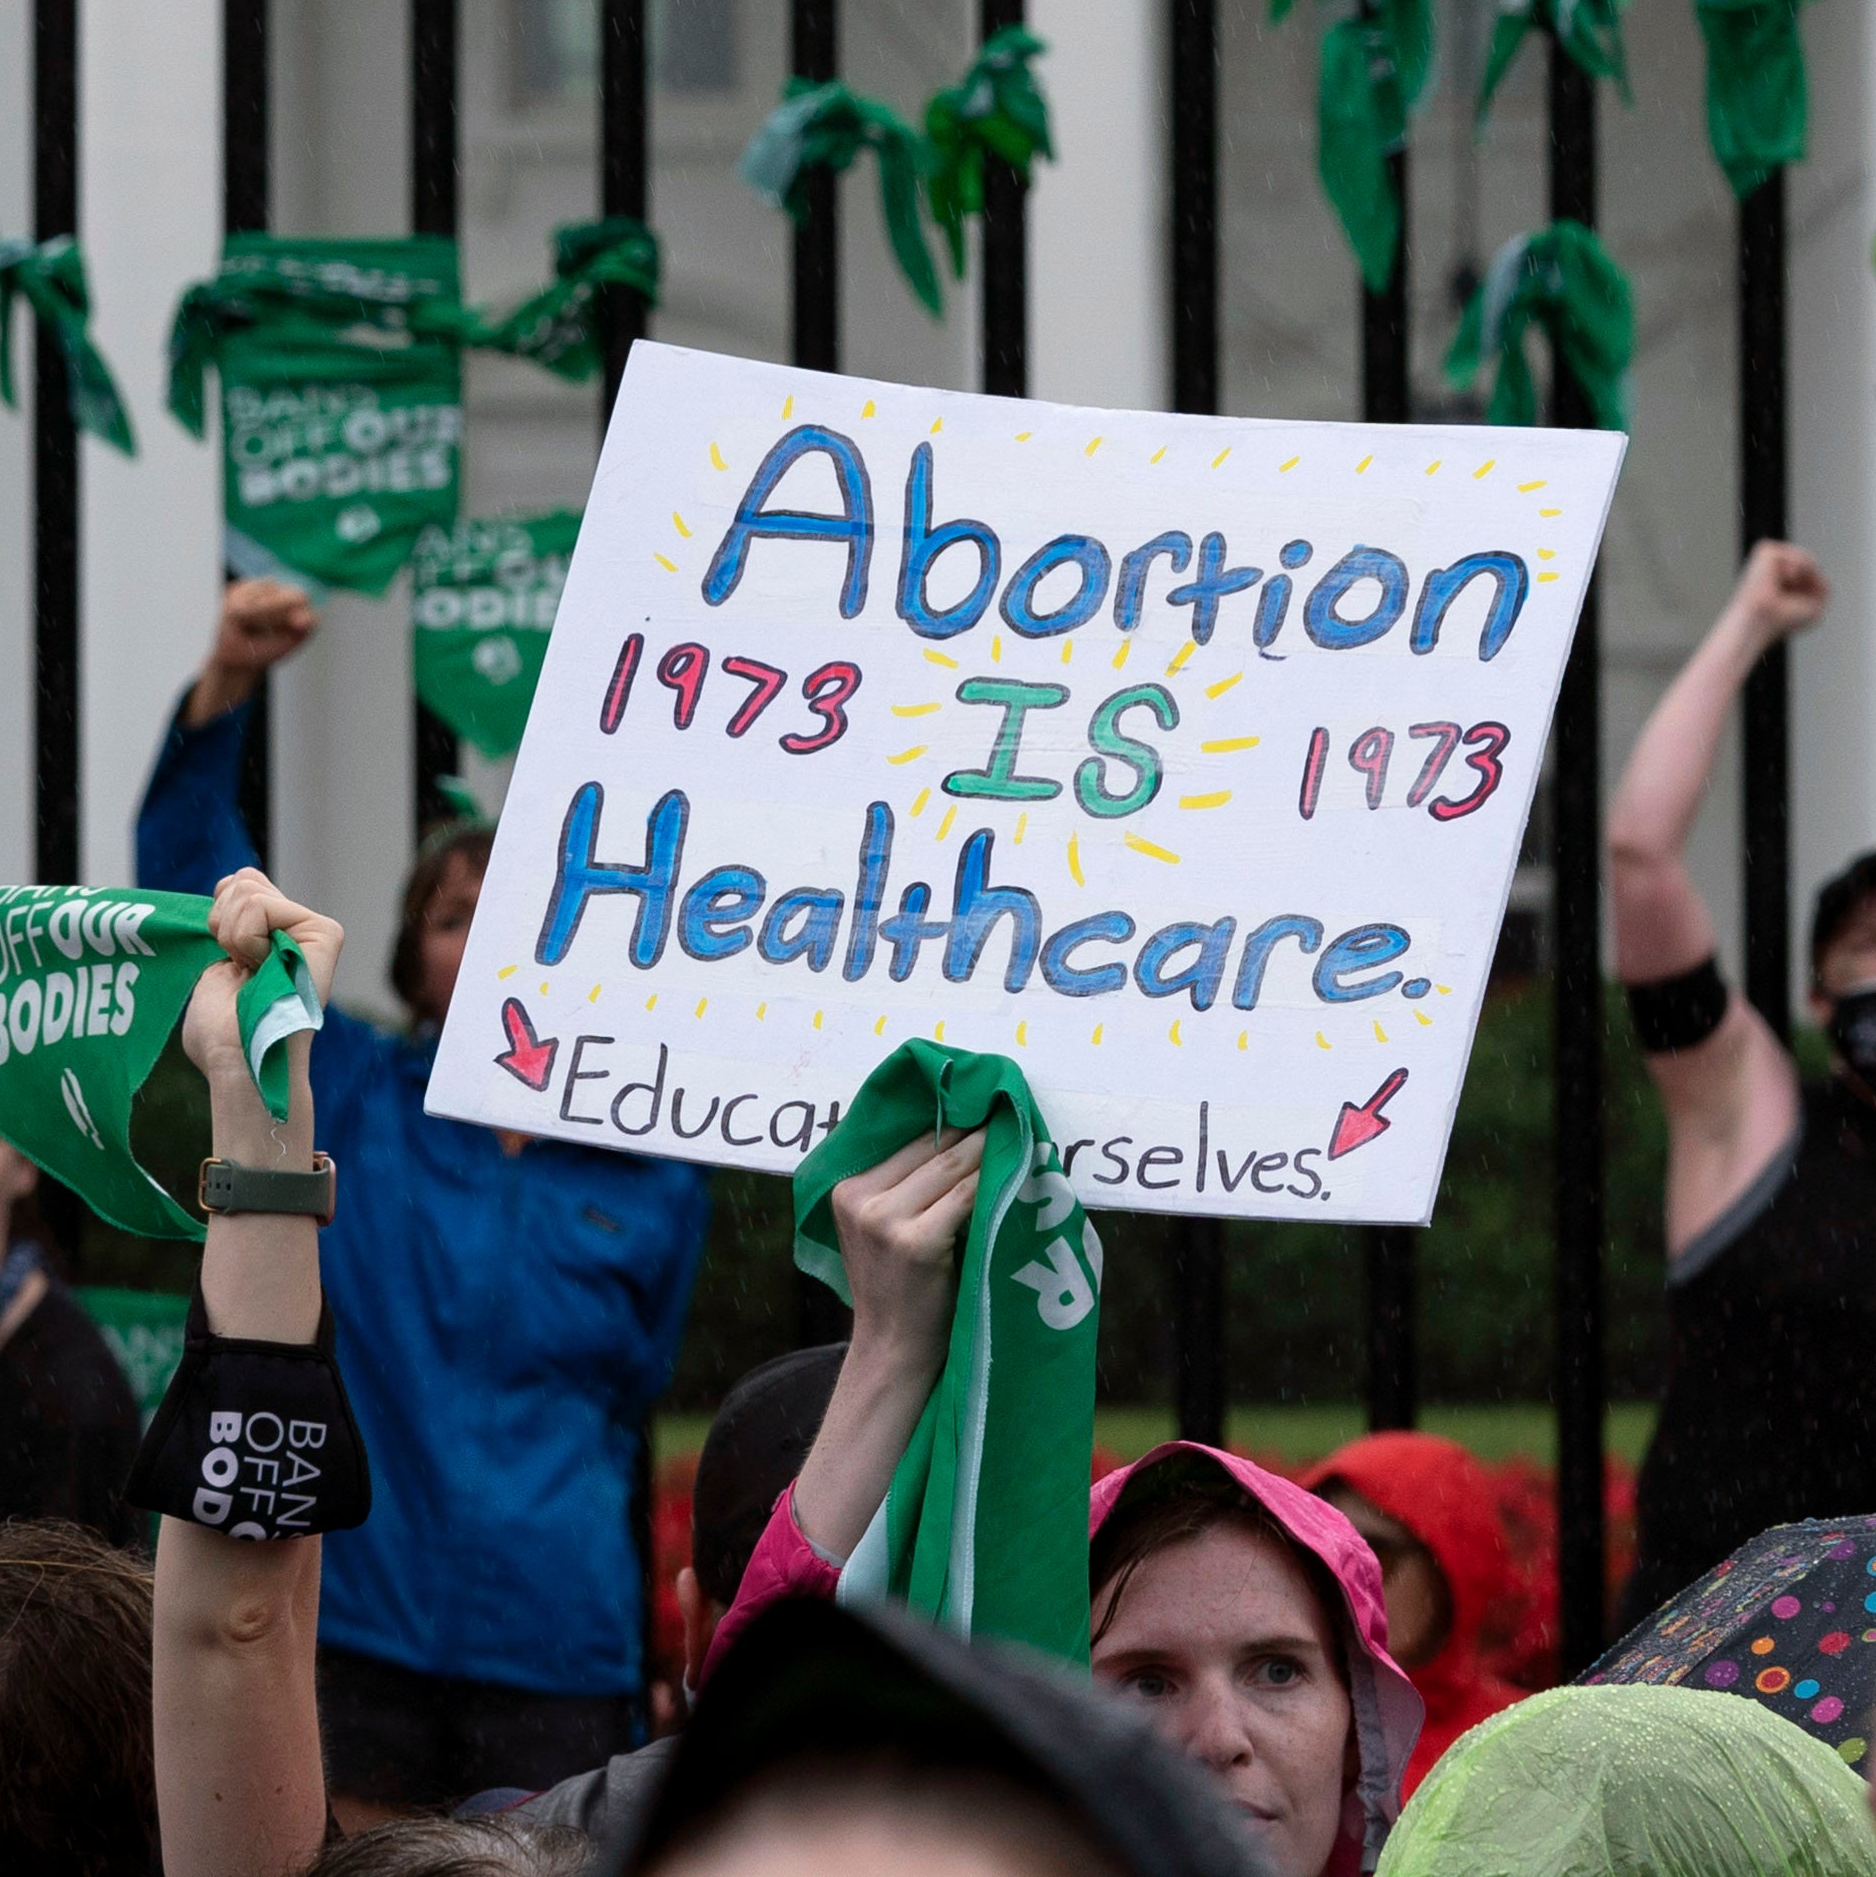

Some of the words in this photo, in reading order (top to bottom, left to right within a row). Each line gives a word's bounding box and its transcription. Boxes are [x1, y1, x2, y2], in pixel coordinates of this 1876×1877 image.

[237, 449, 453, 507] BODIES
[415, 522, 535, 559] ANS
[700, 423, 1530, 662] Abortion
[417, 584, 560, 631] ODIE
[600, 632, 863, 754] 1973
[941, 675, 1182, 820] IS
[1298, 719, 1512, 822] 1973
[48, 899, 157, 960] OUR
[534, 781, 1433, 1013] Healthcare.
[558, 1035, 842, 1155] Educat
[1053, 1102, 1331, 1202] rselves.
[191, 1410, 244, 1525] BOD
[239, 1411, 285, 1516] OFF
[276, 1419, 327, 1534] BAN
